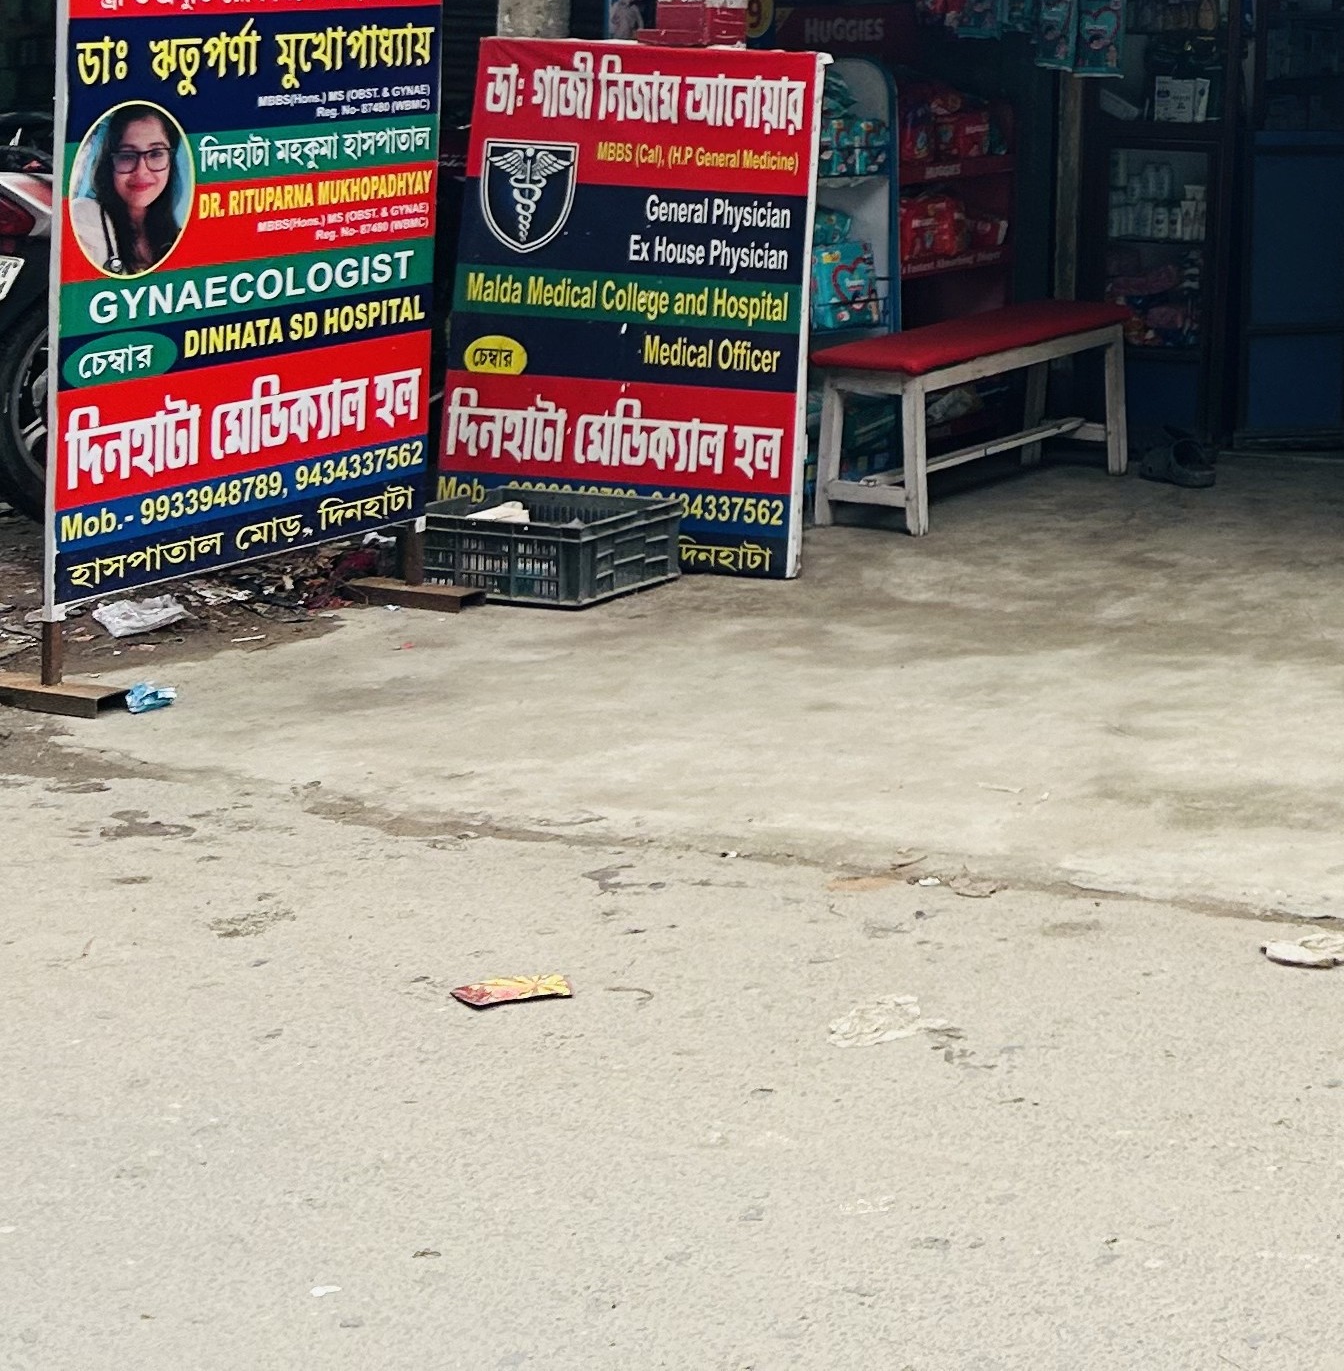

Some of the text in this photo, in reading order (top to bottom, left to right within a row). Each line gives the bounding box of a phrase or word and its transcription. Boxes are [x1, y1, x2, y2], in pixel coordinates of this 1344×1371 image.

[76, 18, 435, 97] ডাঃ ঋতুপর্ণা মুখোপাধ্যায়
[804, 17, 885, 43] HUGGIES
[531, 51, 806, 135] গাজী নিজাম আনোয়ার
[199, 125, 431, 175] দিনহাটা মহকুমা হাসপাতাল
[199, 169, 433, 220] DR. RITUPARNA MUKHOPADHYAY
[89, 250, 414, 324] GYNAECOLOGIST
[184, 294, 425, 358] DINHATA SD HOSPITAL
[643, 335, 781, 373] Medical Officer
[79, 343, 153, 380] চেম্বার
[65, 368, 421, 491] দিনহাটা মেডিক্যাল হল
[60, 440, 424, 543] Mob.- 9933948789, 9434337562
[67, 530, 224, 588] হাসপাতাল
[319, 485, 414, 529] দিনহাটা
